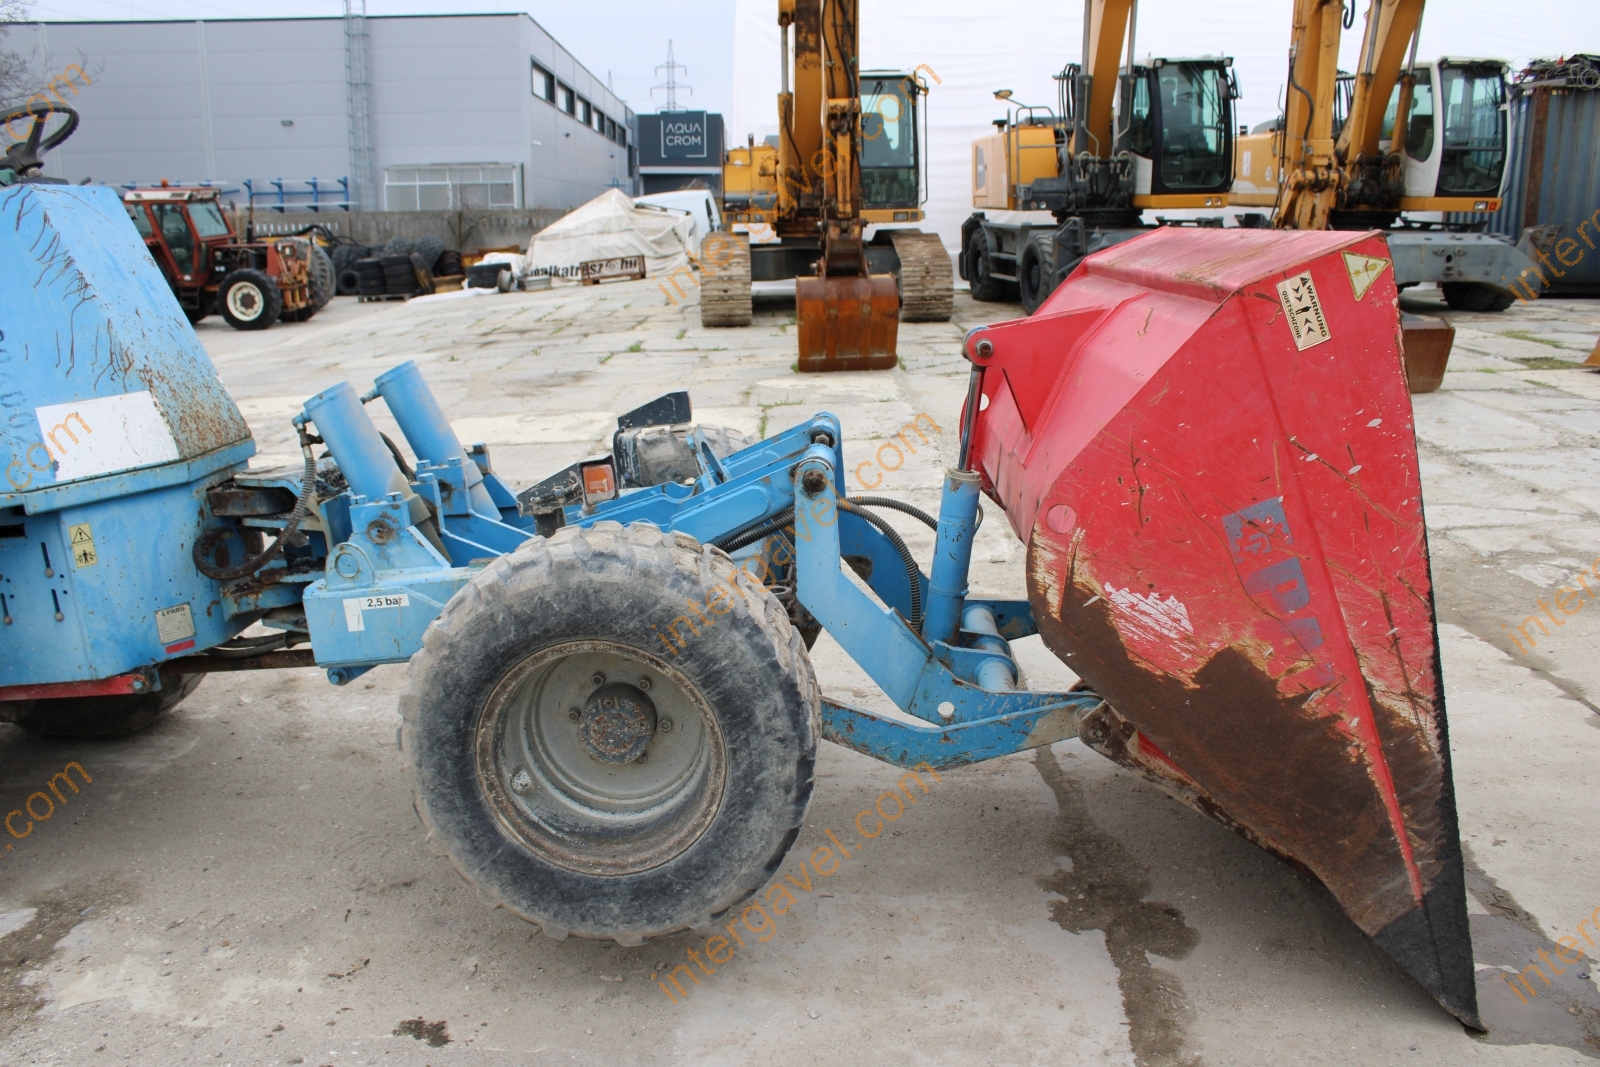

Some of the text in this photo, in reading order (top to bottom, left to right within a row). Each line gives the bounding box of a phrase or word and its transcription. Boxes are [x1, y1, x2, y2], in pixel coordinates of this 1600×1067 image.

[665, 122, 702, 134] AQUA
[665, 135, 702, 146] CROM
[1282, 290, 1302, 340] QUETSCHZONE
[1306, 284, 1327, 338] WARNUNG
[366, 596, 402, 608] 2,5 bar
